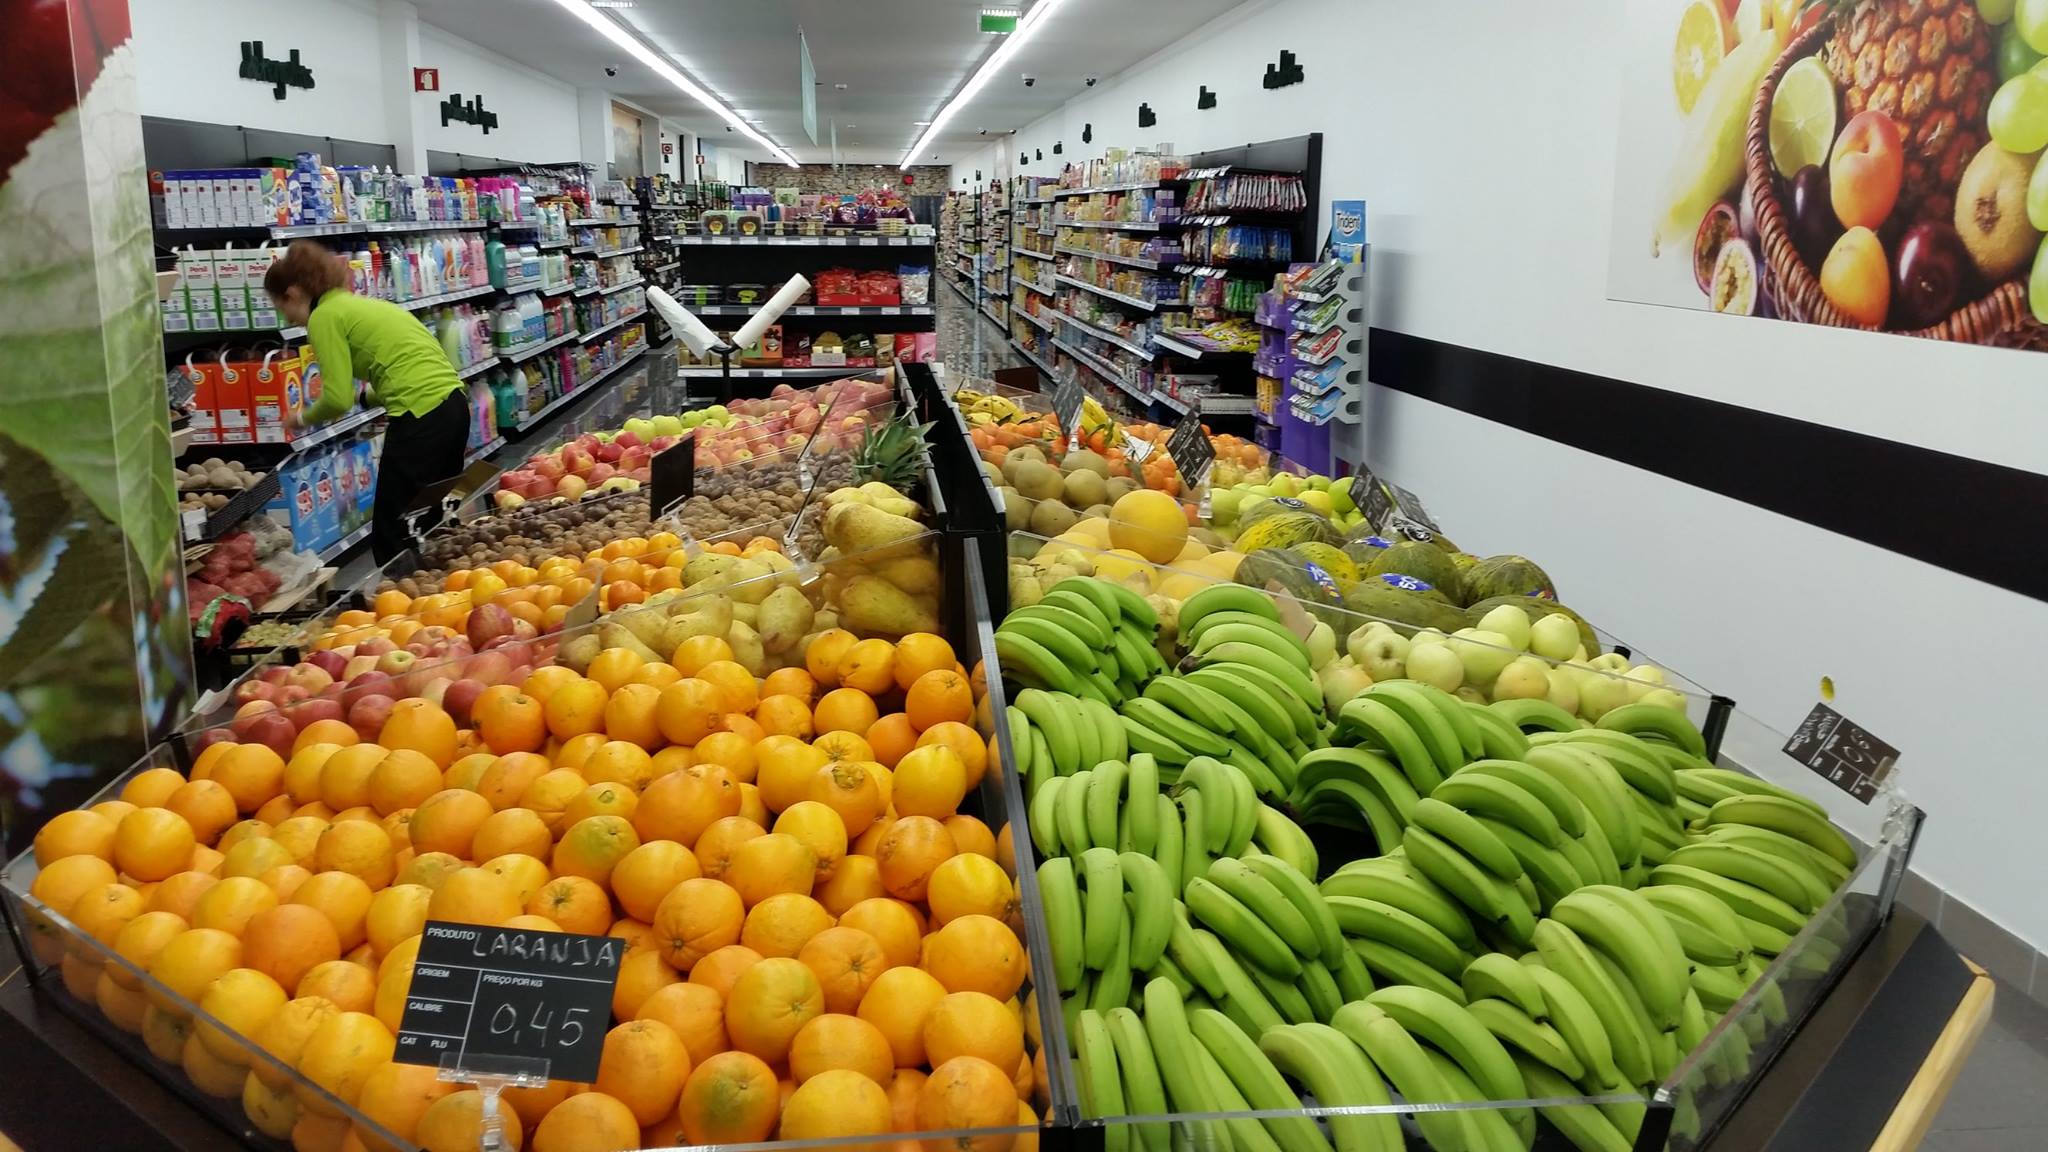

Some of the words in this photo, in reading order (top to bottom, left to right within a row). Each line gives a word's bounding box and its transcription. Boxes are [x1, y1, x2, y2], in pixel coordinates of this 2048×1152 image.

[1336, 211, 1361, 231] Trident
[427, 927, 474, 941] PRODUTO
[473, 932, 615, 967] LARANJA
[417, 968, 450, 978] ORIGEM
[483, 974, 511, 985] PREÇO
[512, 977, 530, 986] POR
[530, 979, 543, 988] KG
[408, 1001, 443, 1013] CALIBRE
[490, 1001, 590, 1048] 0,45
[400, 1036, 417, 1046] CAT
[430, 1039, 448, 1049] PLU
